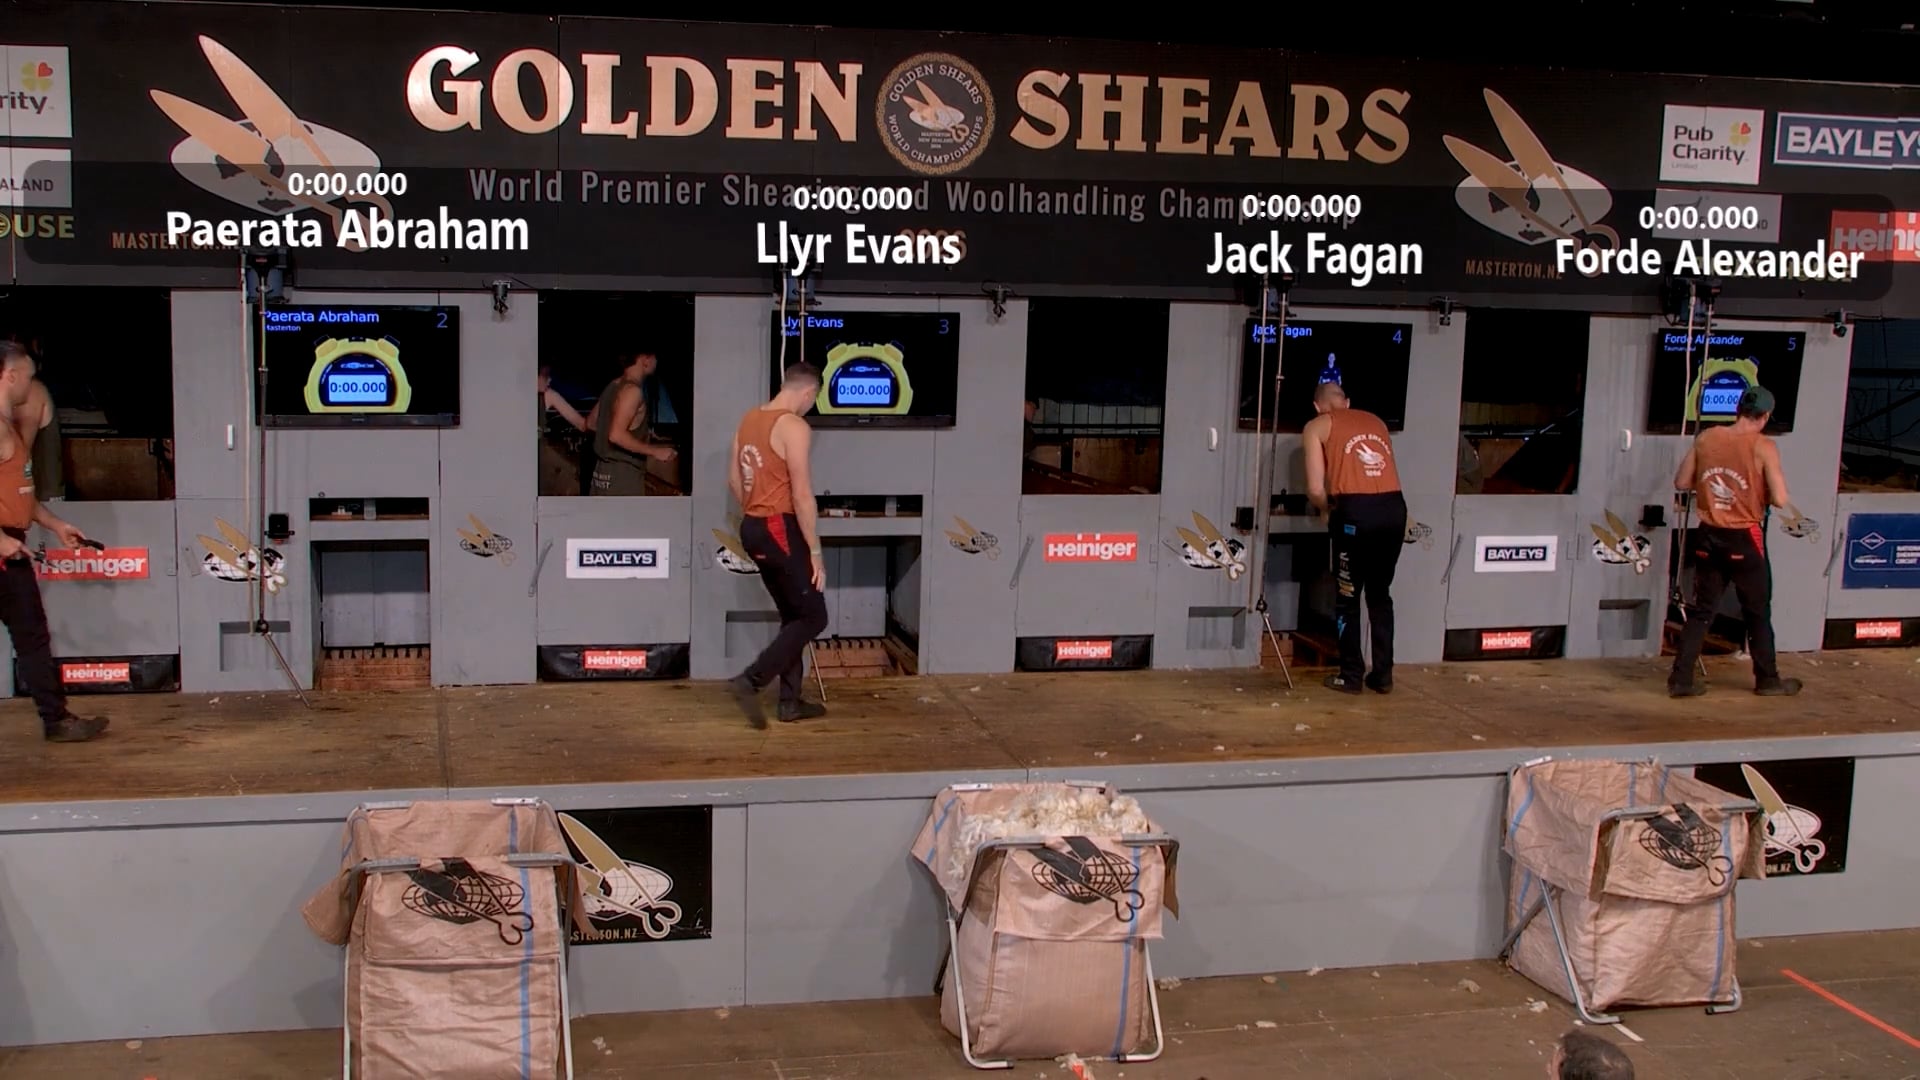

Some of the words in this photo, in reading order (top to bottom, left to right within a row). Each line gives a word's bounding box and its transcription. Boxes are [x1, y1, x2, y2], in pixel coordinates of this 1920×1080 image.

[889, 64, 934, 102] GOLDEN
[939, 65, 983, 104] SHEARS
[407, 46, 863, 142] GOLDEN
[1009, 69, 1412, 164] SHEARS
[889, 114, 910, 152] WORLD
[911, 116, 984, 164] CHAMPIONSHIPS
[1674, 125, 1713, 142] Pub
[1787, 126, 1920, 158] BAYLEY
[1673, 144, 1745, 166] Charity
[469, 168, 562, 201] World
[581, 171, 706, 206] Premier
[722, 174, 861, 215] Sheaig
[946, 181, 1145, 222] Woolhandling
[319, 310, 380, 322] Abraham
[436, 312, 448, 328] 2
[807, 316, 844, 328] Evans
[938, 319, 949, 334] 3
[1392, 330, 1403, 344] 4
[1787, 337, 1797, 351] 5
[330, 382, 387, 393] 0:00.000
[838, 385, 890, 396] 0:00.000
[1704, 395, 1740, 405] 0:00.00
[1047, 533, 1136, 560] Heiniger
[1487, 548, 1544, 559] BAYLEYS
[582, 552, 653, 565] BAYLEYS
[1855, 622, 1898, 637] Heiniger
[1482, 632, 1530, 647] Heiniger
[1057, 641, 1110, 658] Heiniger
[587, 651, 645, 667] Heiniger
[65, 664, 129, 681] Heiniger
